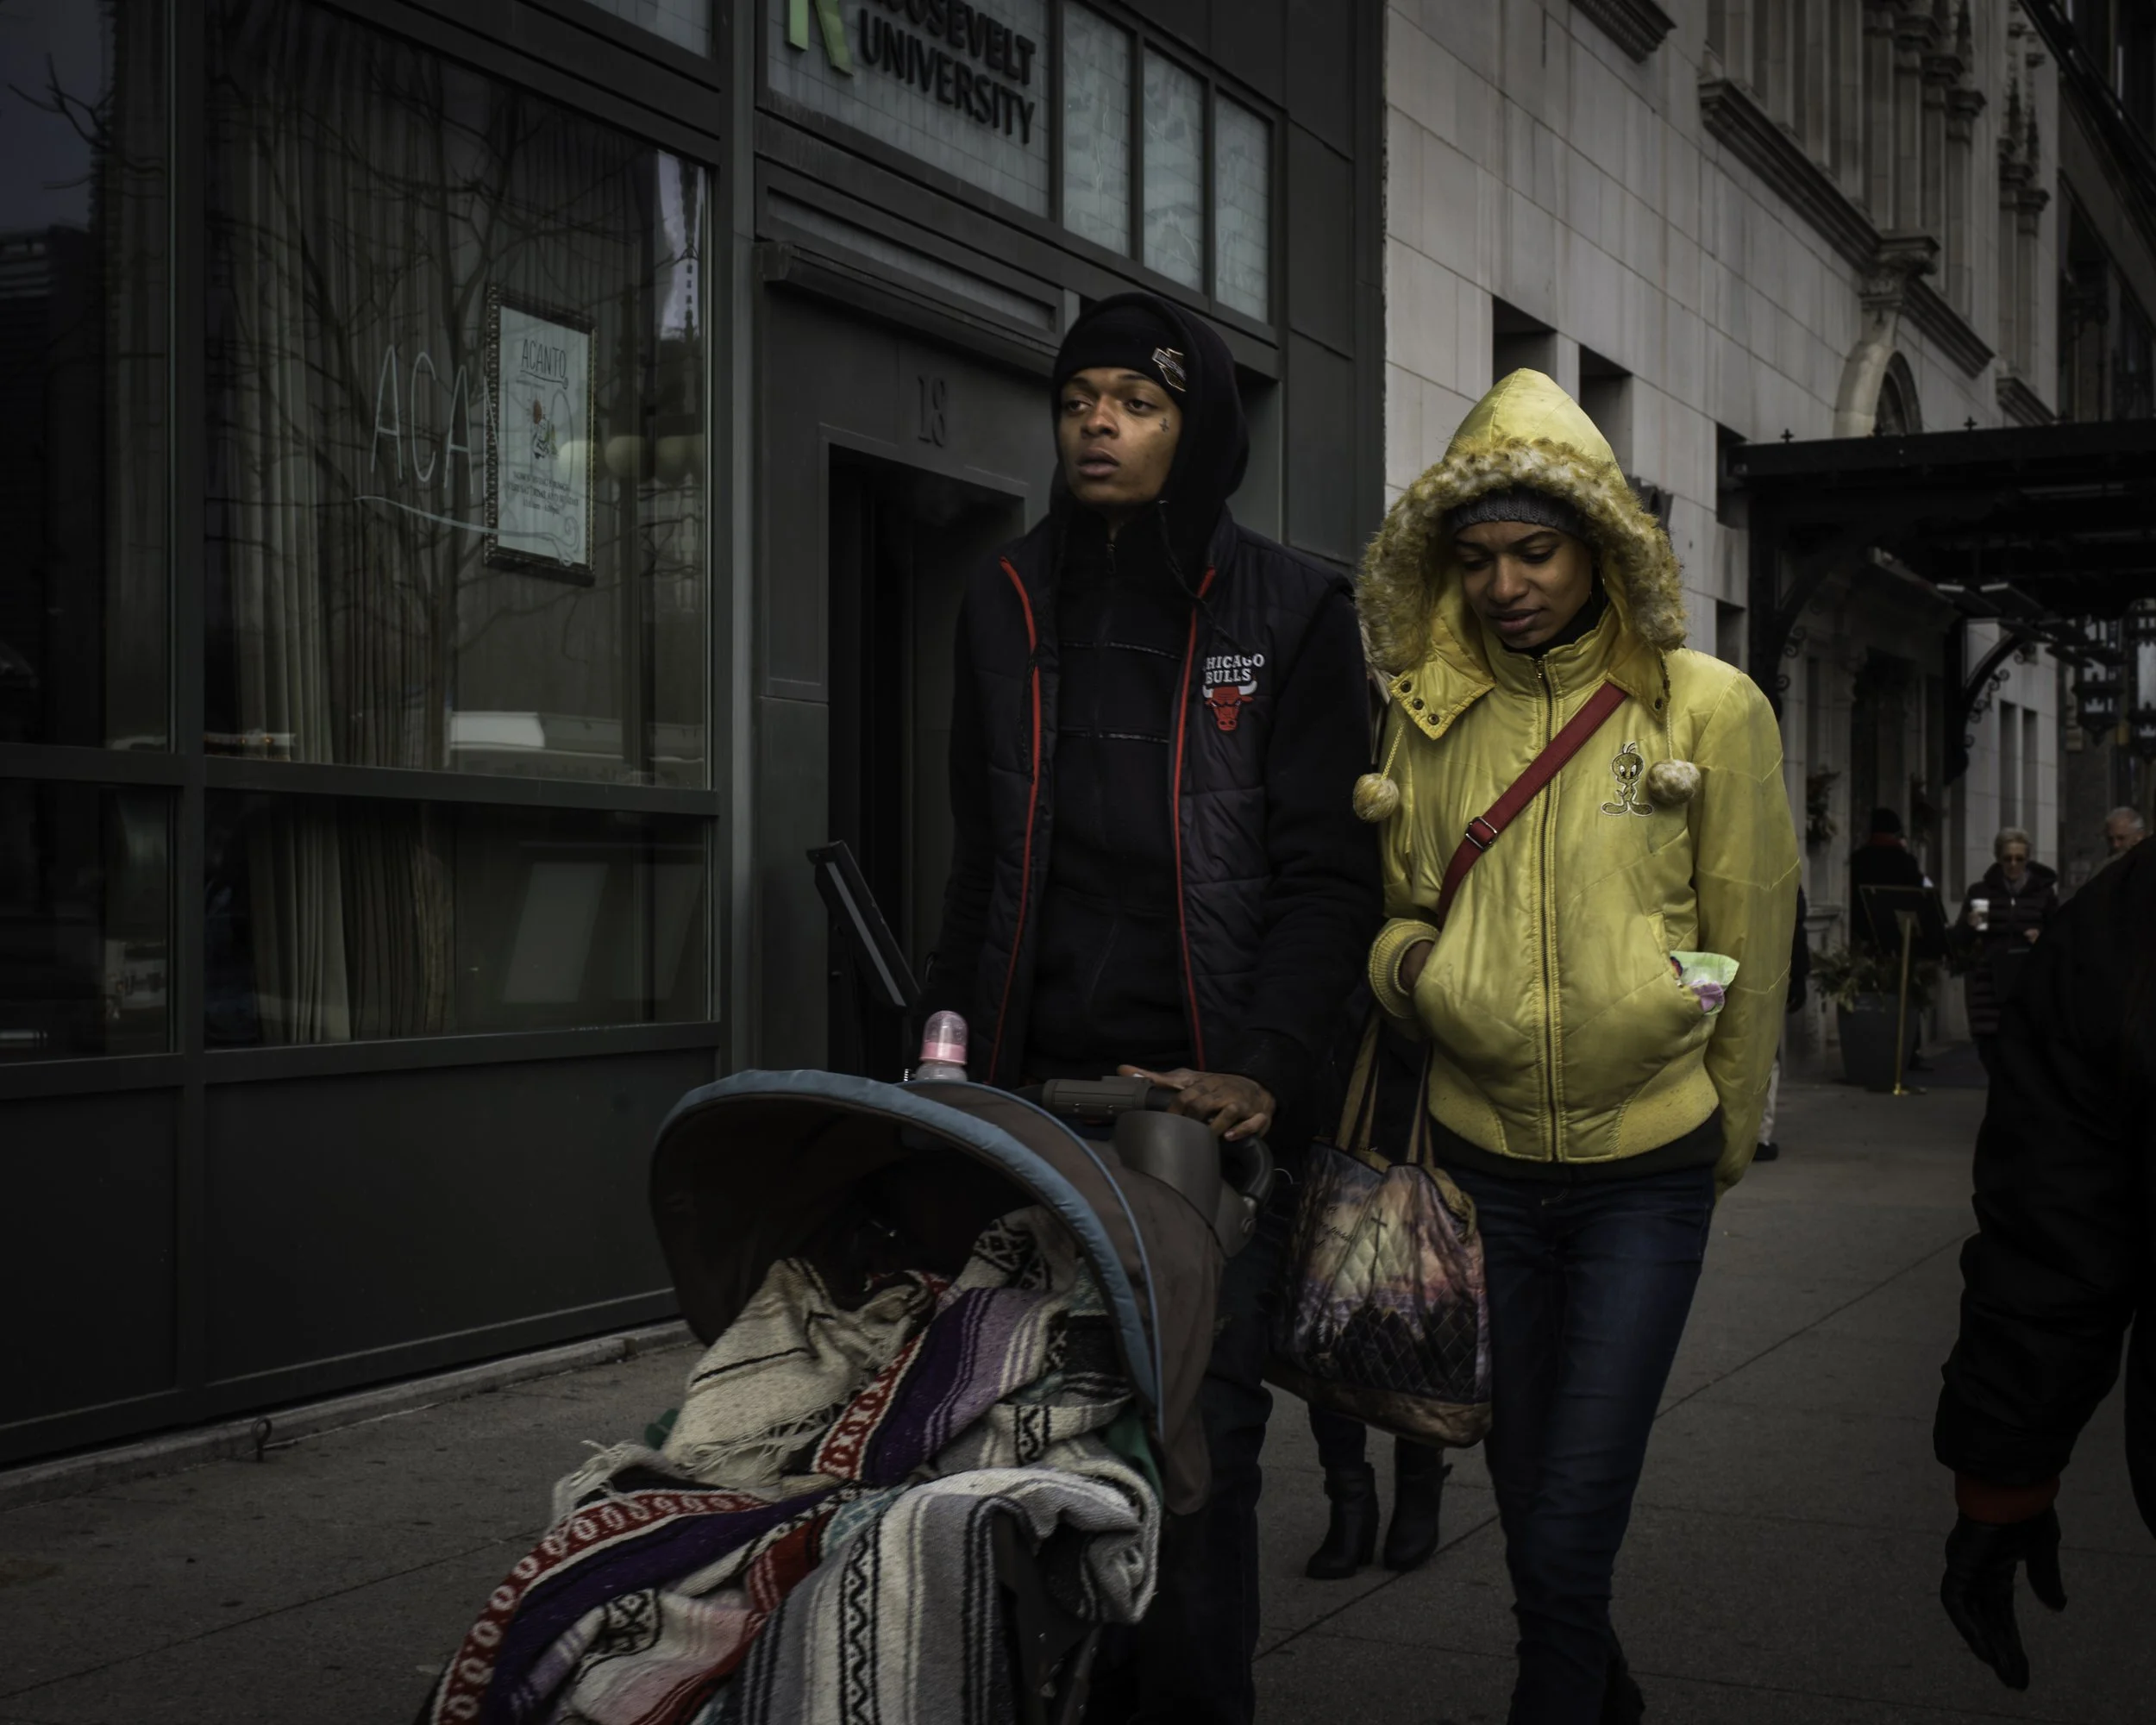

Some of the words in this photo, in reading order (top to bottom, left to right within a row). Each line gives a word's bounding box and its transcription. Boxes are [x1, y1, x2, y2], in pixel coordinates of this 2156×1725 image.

[876, 0, 1037, 85] OSEVELT
[859, 8, 1035, 144] UNIVERSITY
[521, 338, 567, 379] ACANTO
[917, 375, 946, 448] 18
[1204, 653, 1265, 670] HICAGO
[1205, 668, 1252, 684] BULLS
